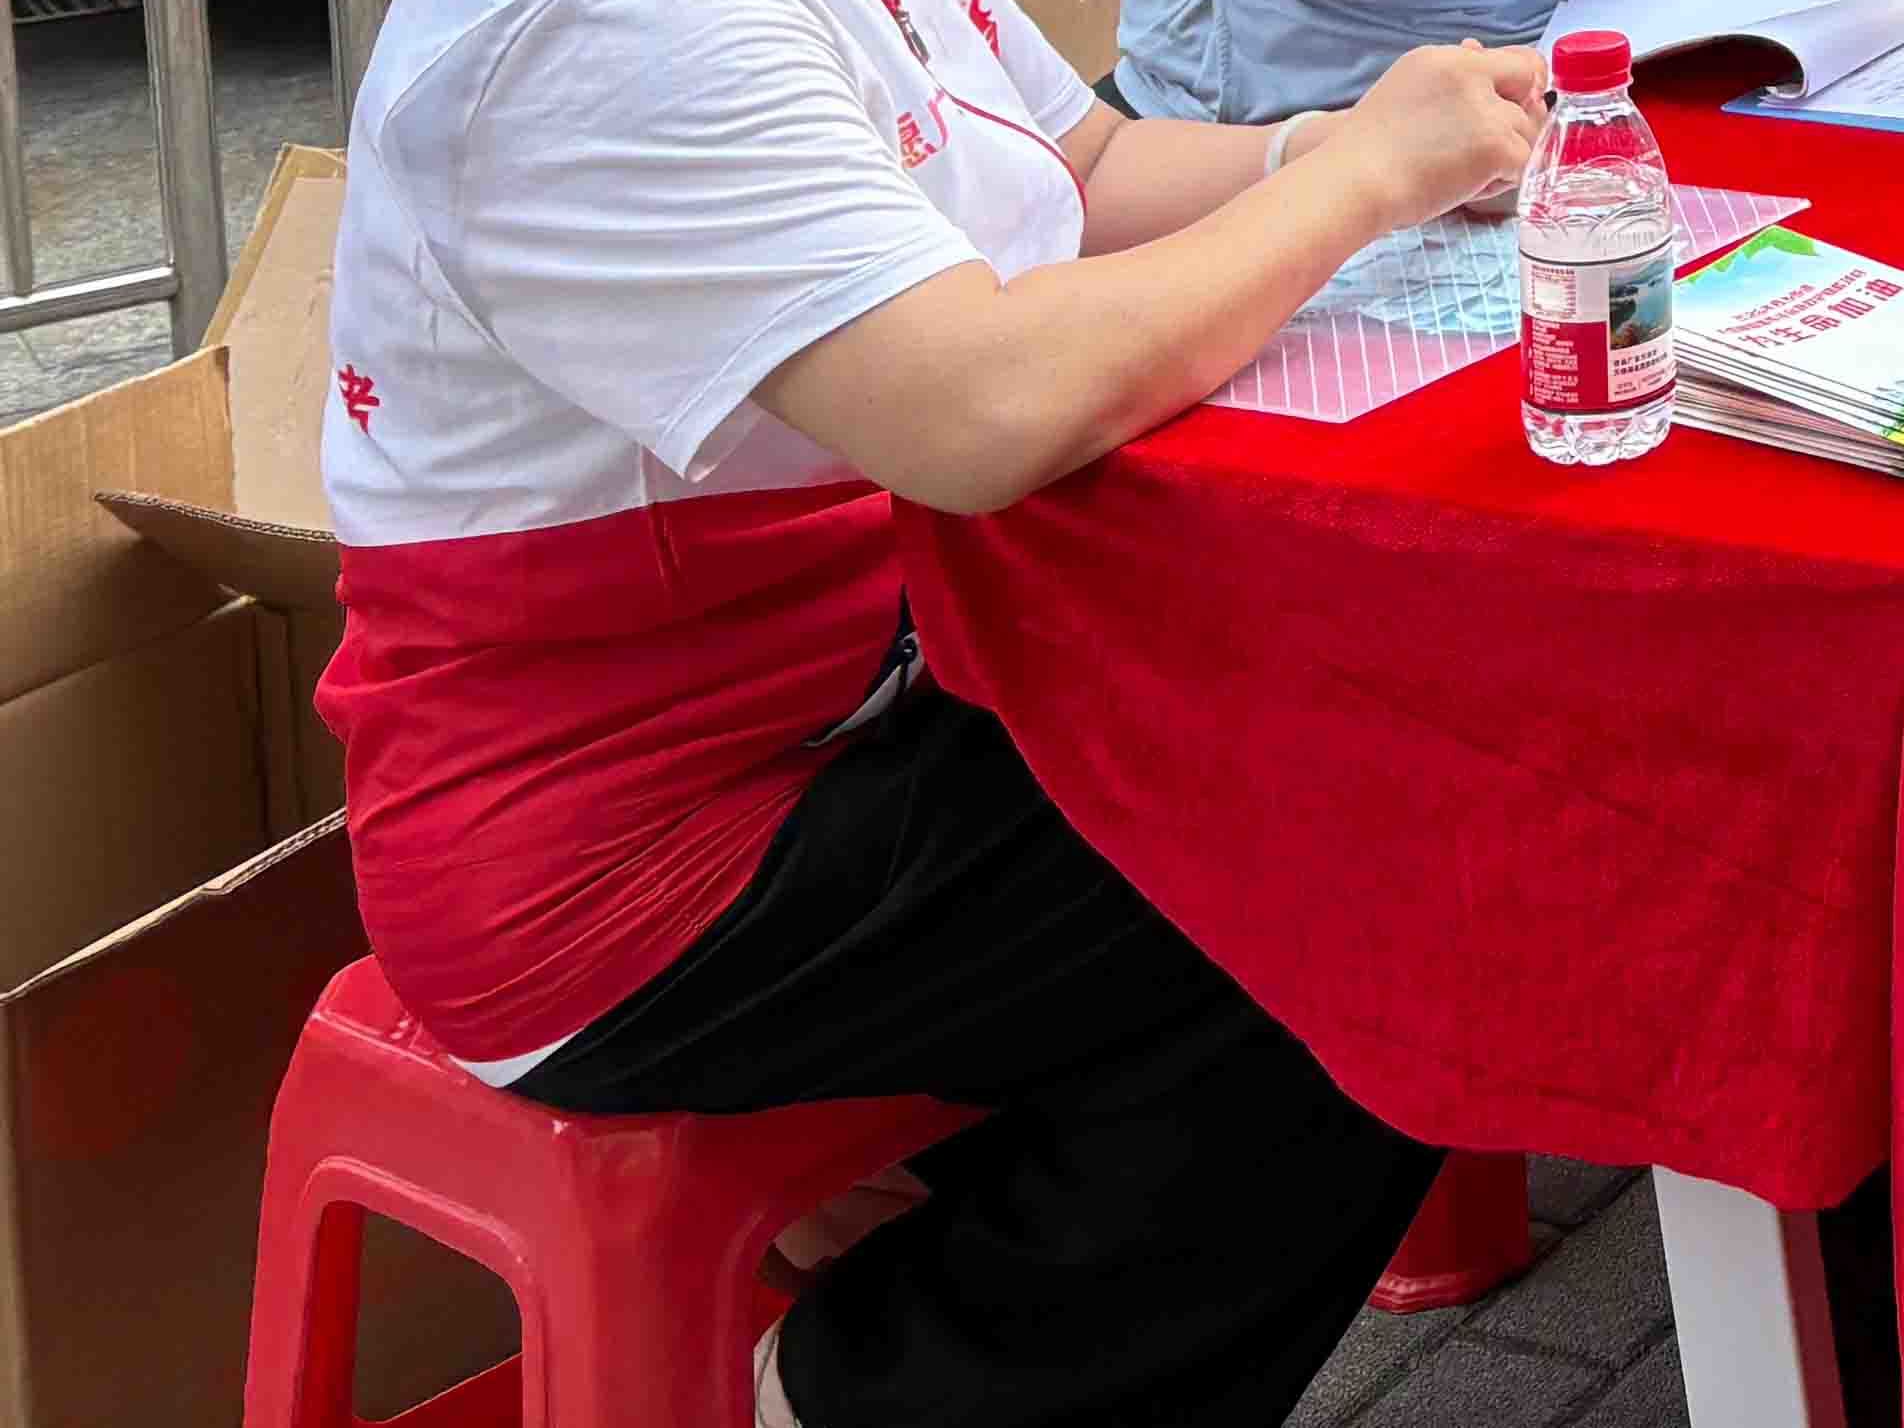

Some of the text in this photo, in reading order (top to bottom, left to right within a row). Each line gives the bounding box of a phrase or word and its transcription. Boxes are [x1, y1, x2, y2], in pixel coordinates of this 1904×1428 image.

[1737, 278, 1904, 349] 为生命加油
